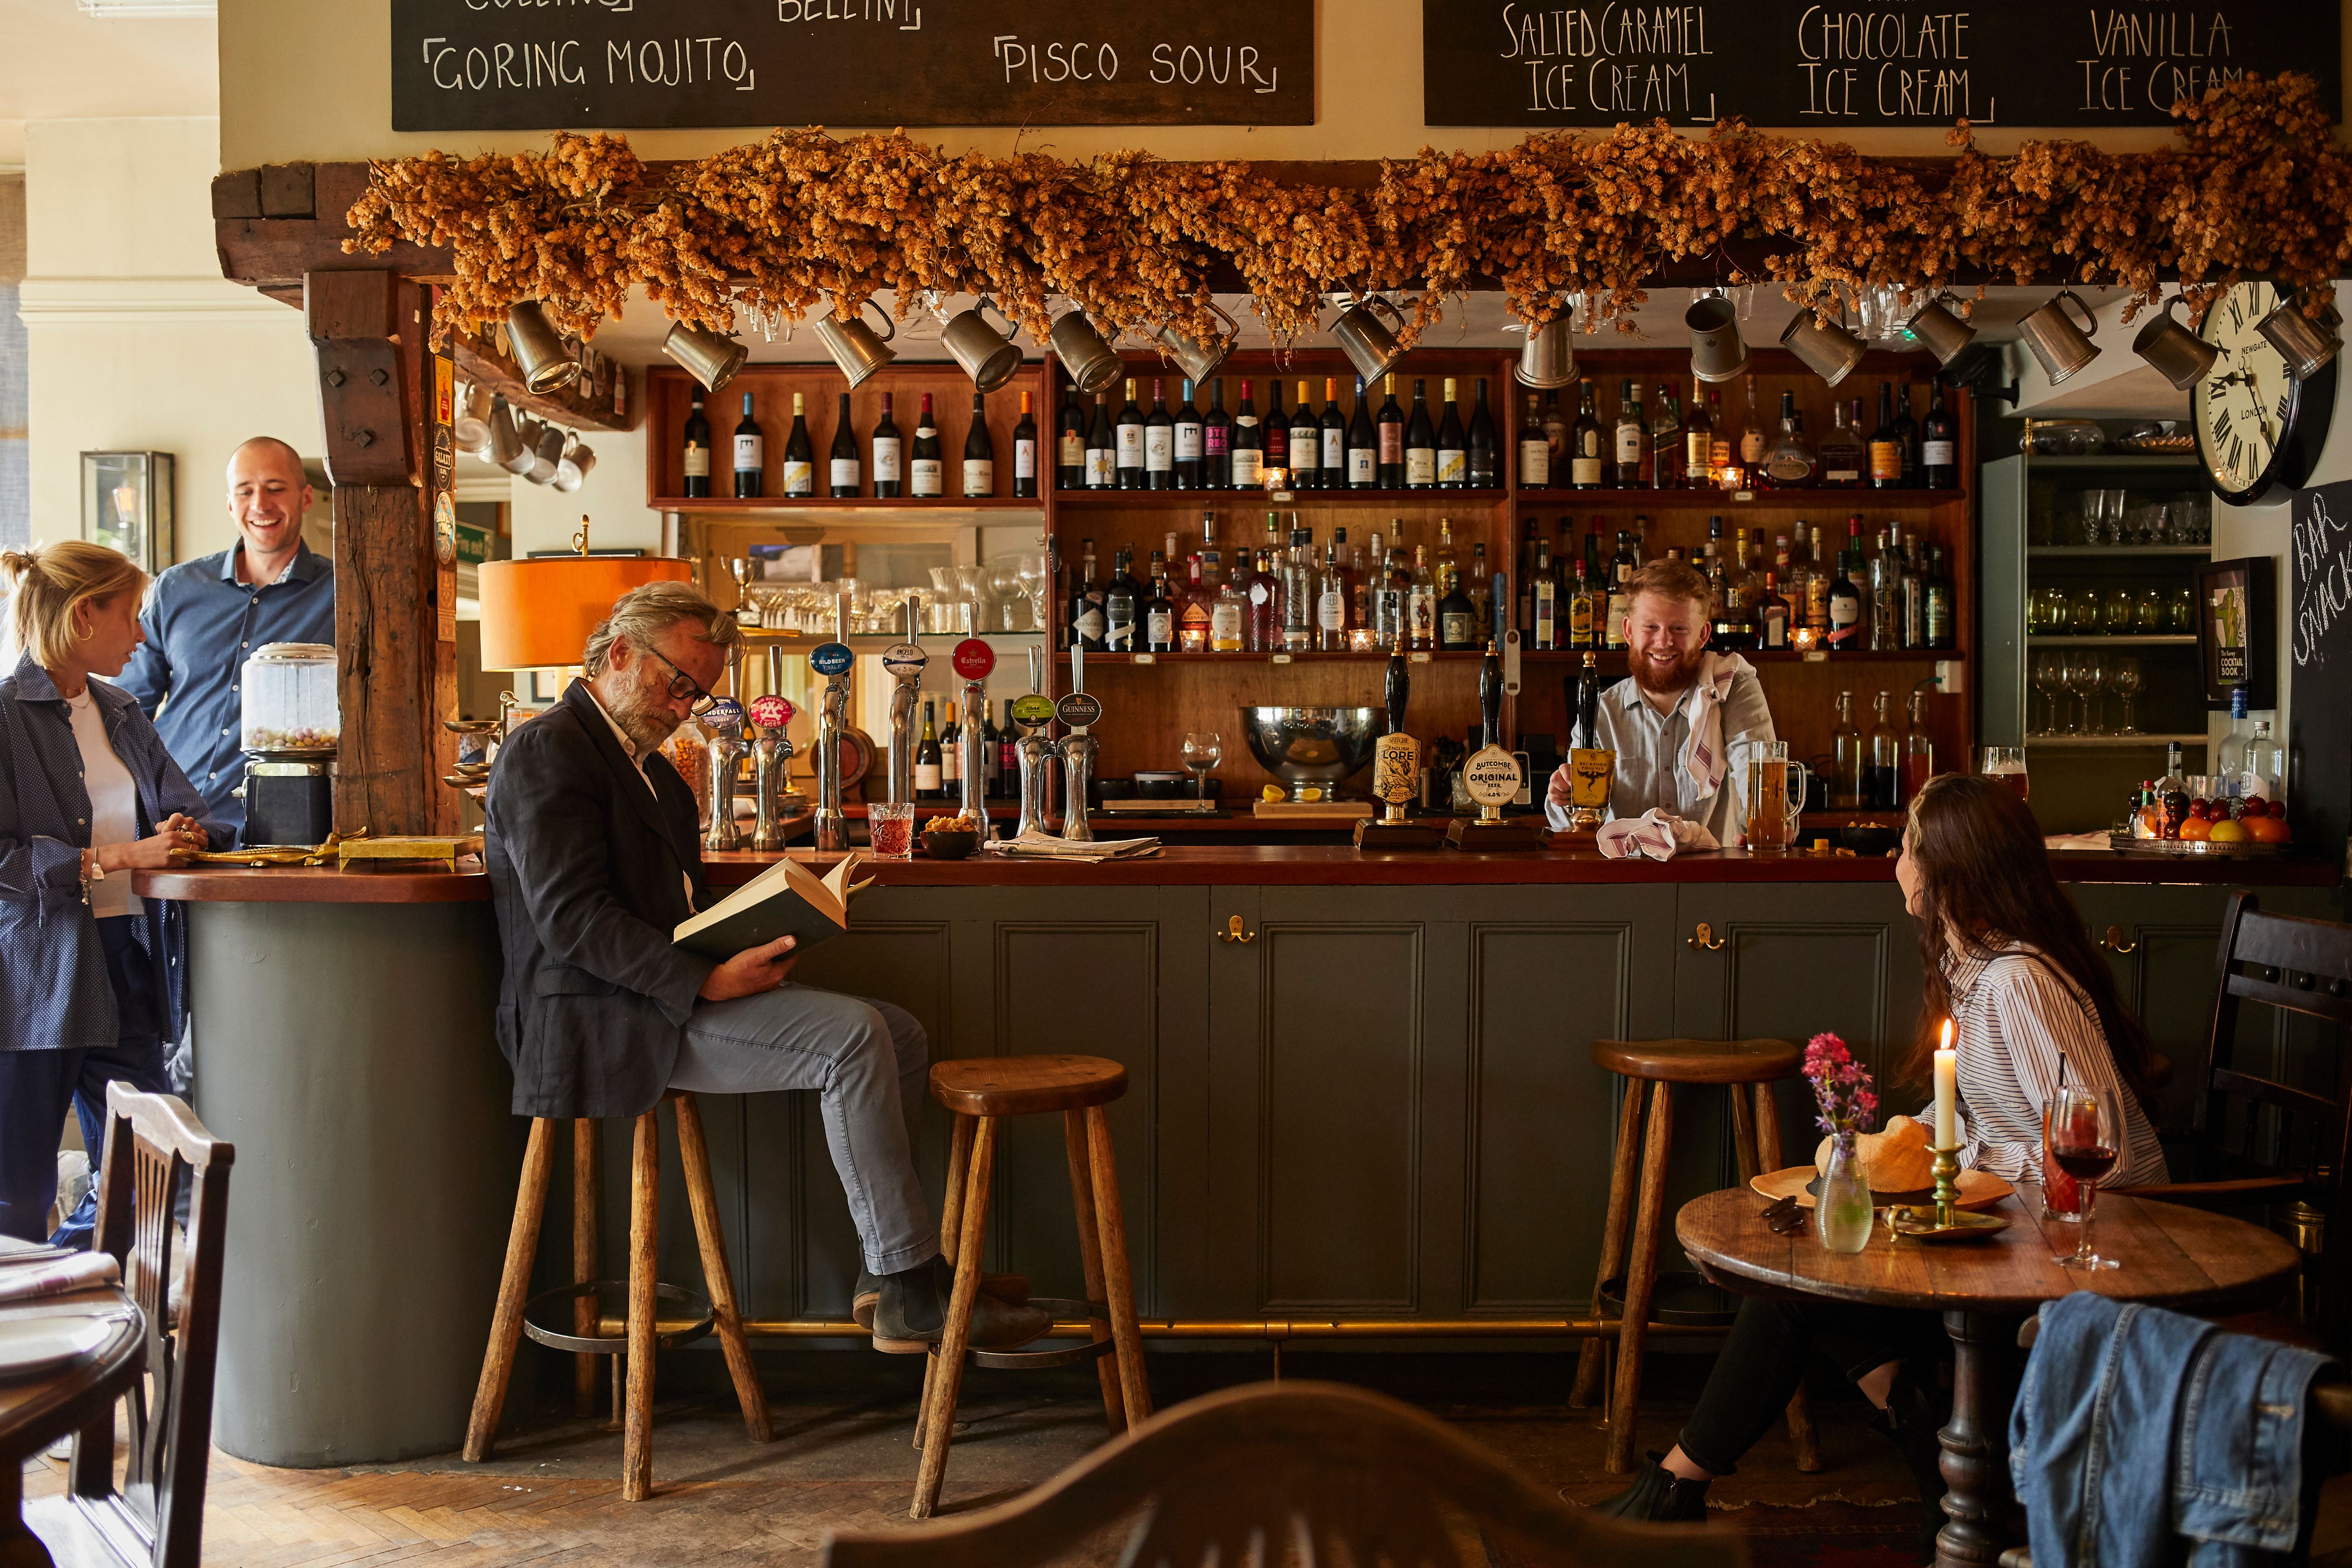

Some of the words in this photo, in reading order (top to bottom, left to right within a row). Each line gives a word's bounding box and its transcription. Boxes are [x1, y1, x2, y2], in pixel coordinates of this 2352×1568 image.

[1500, 2, 1596, 58] SALTED
[1601, 1, 1713, 56] CARAMEL
[1798, 5, 1969, 60] CHOCOLATE
[2090, 9, 2233, 57] VANILLA
[434, 40, 586, 90] GORING
[608, 37, 747, 86] MOJITO
[1004, 42, 1118, 83] PISCO
[1150, 43, 1270, 85] SOUR
[1524, 60, 1575, 111] ICE
[1590, 58, 1689, 112] CREAM
[1797, 63, 1858, 115] ICE
[1879, 62, 1969, 116] CREAM
[2076, 60, 2134, 111] ICE
[2241, 341, 2268, 356] NEWGATE
[2241, 405, 2268, 420] LONDON
[435, 450, 451, 466] GALAXY
[436, 511, 451, 525] SILVER
[438, 522, 451, 537] KING
[2294, 493, 2348, 611] BAR
[2221, 658, 2243, 666] COCKTAIL
[2221, 667, 2238, 676] BOOK
[1062, 705, 1095, 713] GUINNESS
[1383, 750, 1414, 760] LORE
[1475, 761, 1511, 770] BUTCOMBE
[1470, 774, 1517, 783] ORIGINAL
